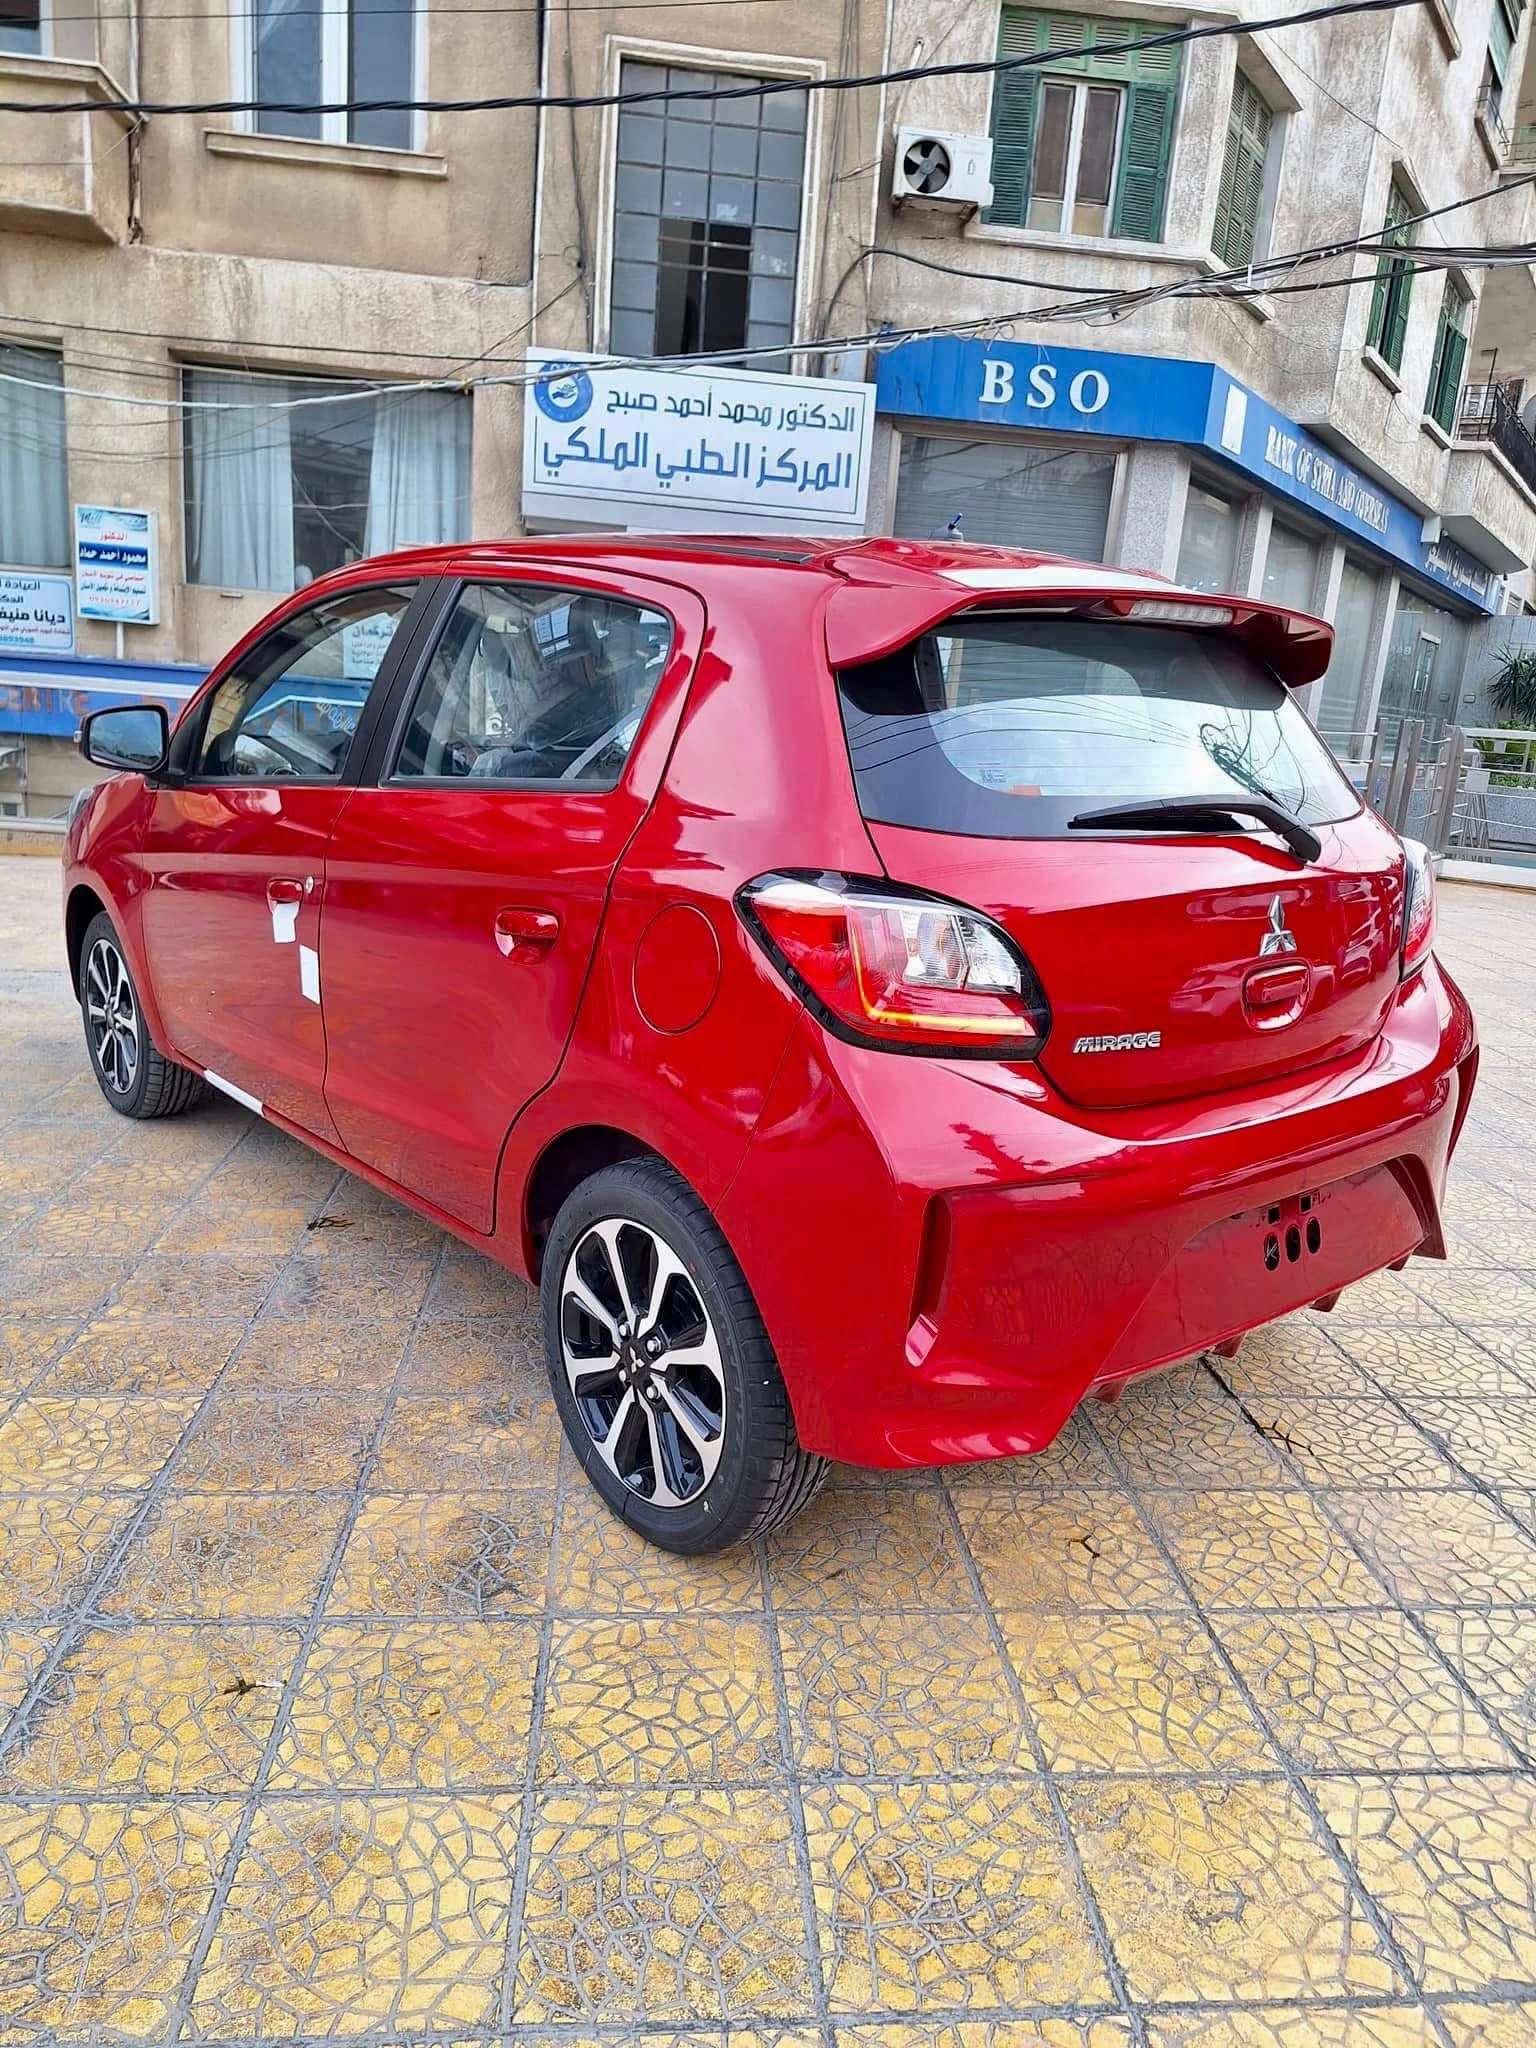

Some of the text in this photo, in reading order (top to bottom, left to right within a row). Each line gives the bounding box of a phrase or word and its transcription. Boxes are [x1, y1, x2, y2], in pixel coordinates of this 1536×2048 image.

[664, 385, 713, 418] أحمد
[979, 359, 1111, 414] BSO
[718, 400, 772, 427] محمد
[776, 401, 856, 432] الدكتور
[543, 426, 853, 492] المركز الطبي الملكي
[1264, 424, 1298, 477] BANK
[1296, 447, 1313, 485] OF
[1310, 456, 1337, 502] SYRIA
[1334, 475, 1356, 513] AND
[34, 608, 66, 626] ديانا
[1073, 1031, 1161, 1054] MIRAGE
